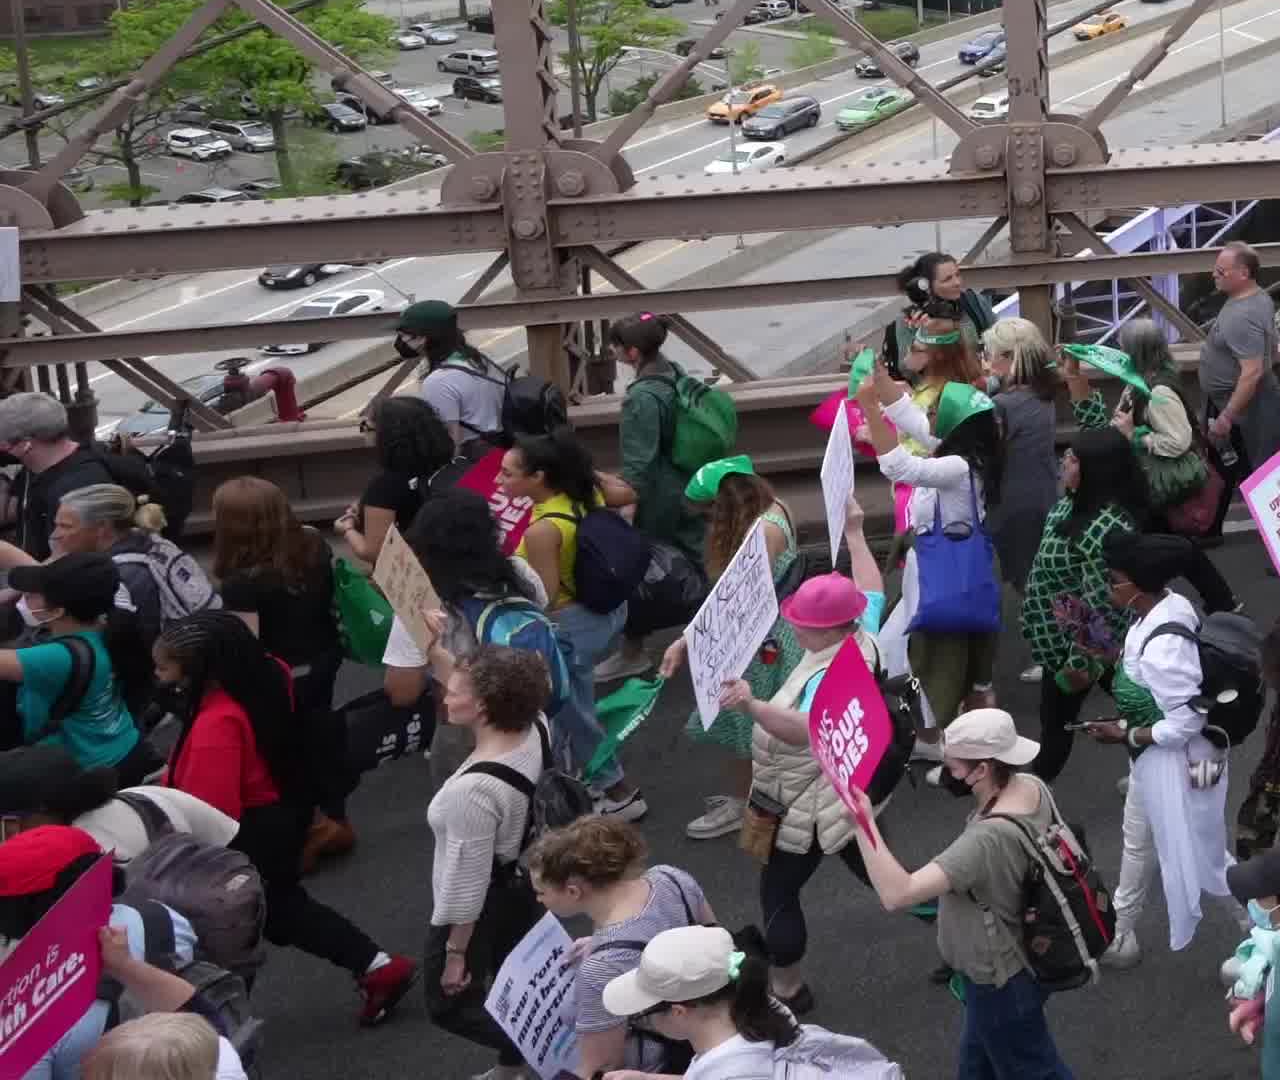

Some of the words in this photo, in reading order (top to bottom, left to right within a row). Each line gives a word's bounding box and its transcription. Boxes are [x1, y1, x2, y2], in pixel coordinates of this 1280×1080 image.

[693, 606, 712, 649] NO
[832, 697, 864, 758] OUR
[838, 726, 869, 789] DIES
[32, 952, 84, 1008] Care.
[46, 944, 60, 968] is
[510, 991, 529, 1025] New
[528, 945, 564, 987] York
[518, 997, 541, 1046] must
[539, 976, 557, 1001] be
